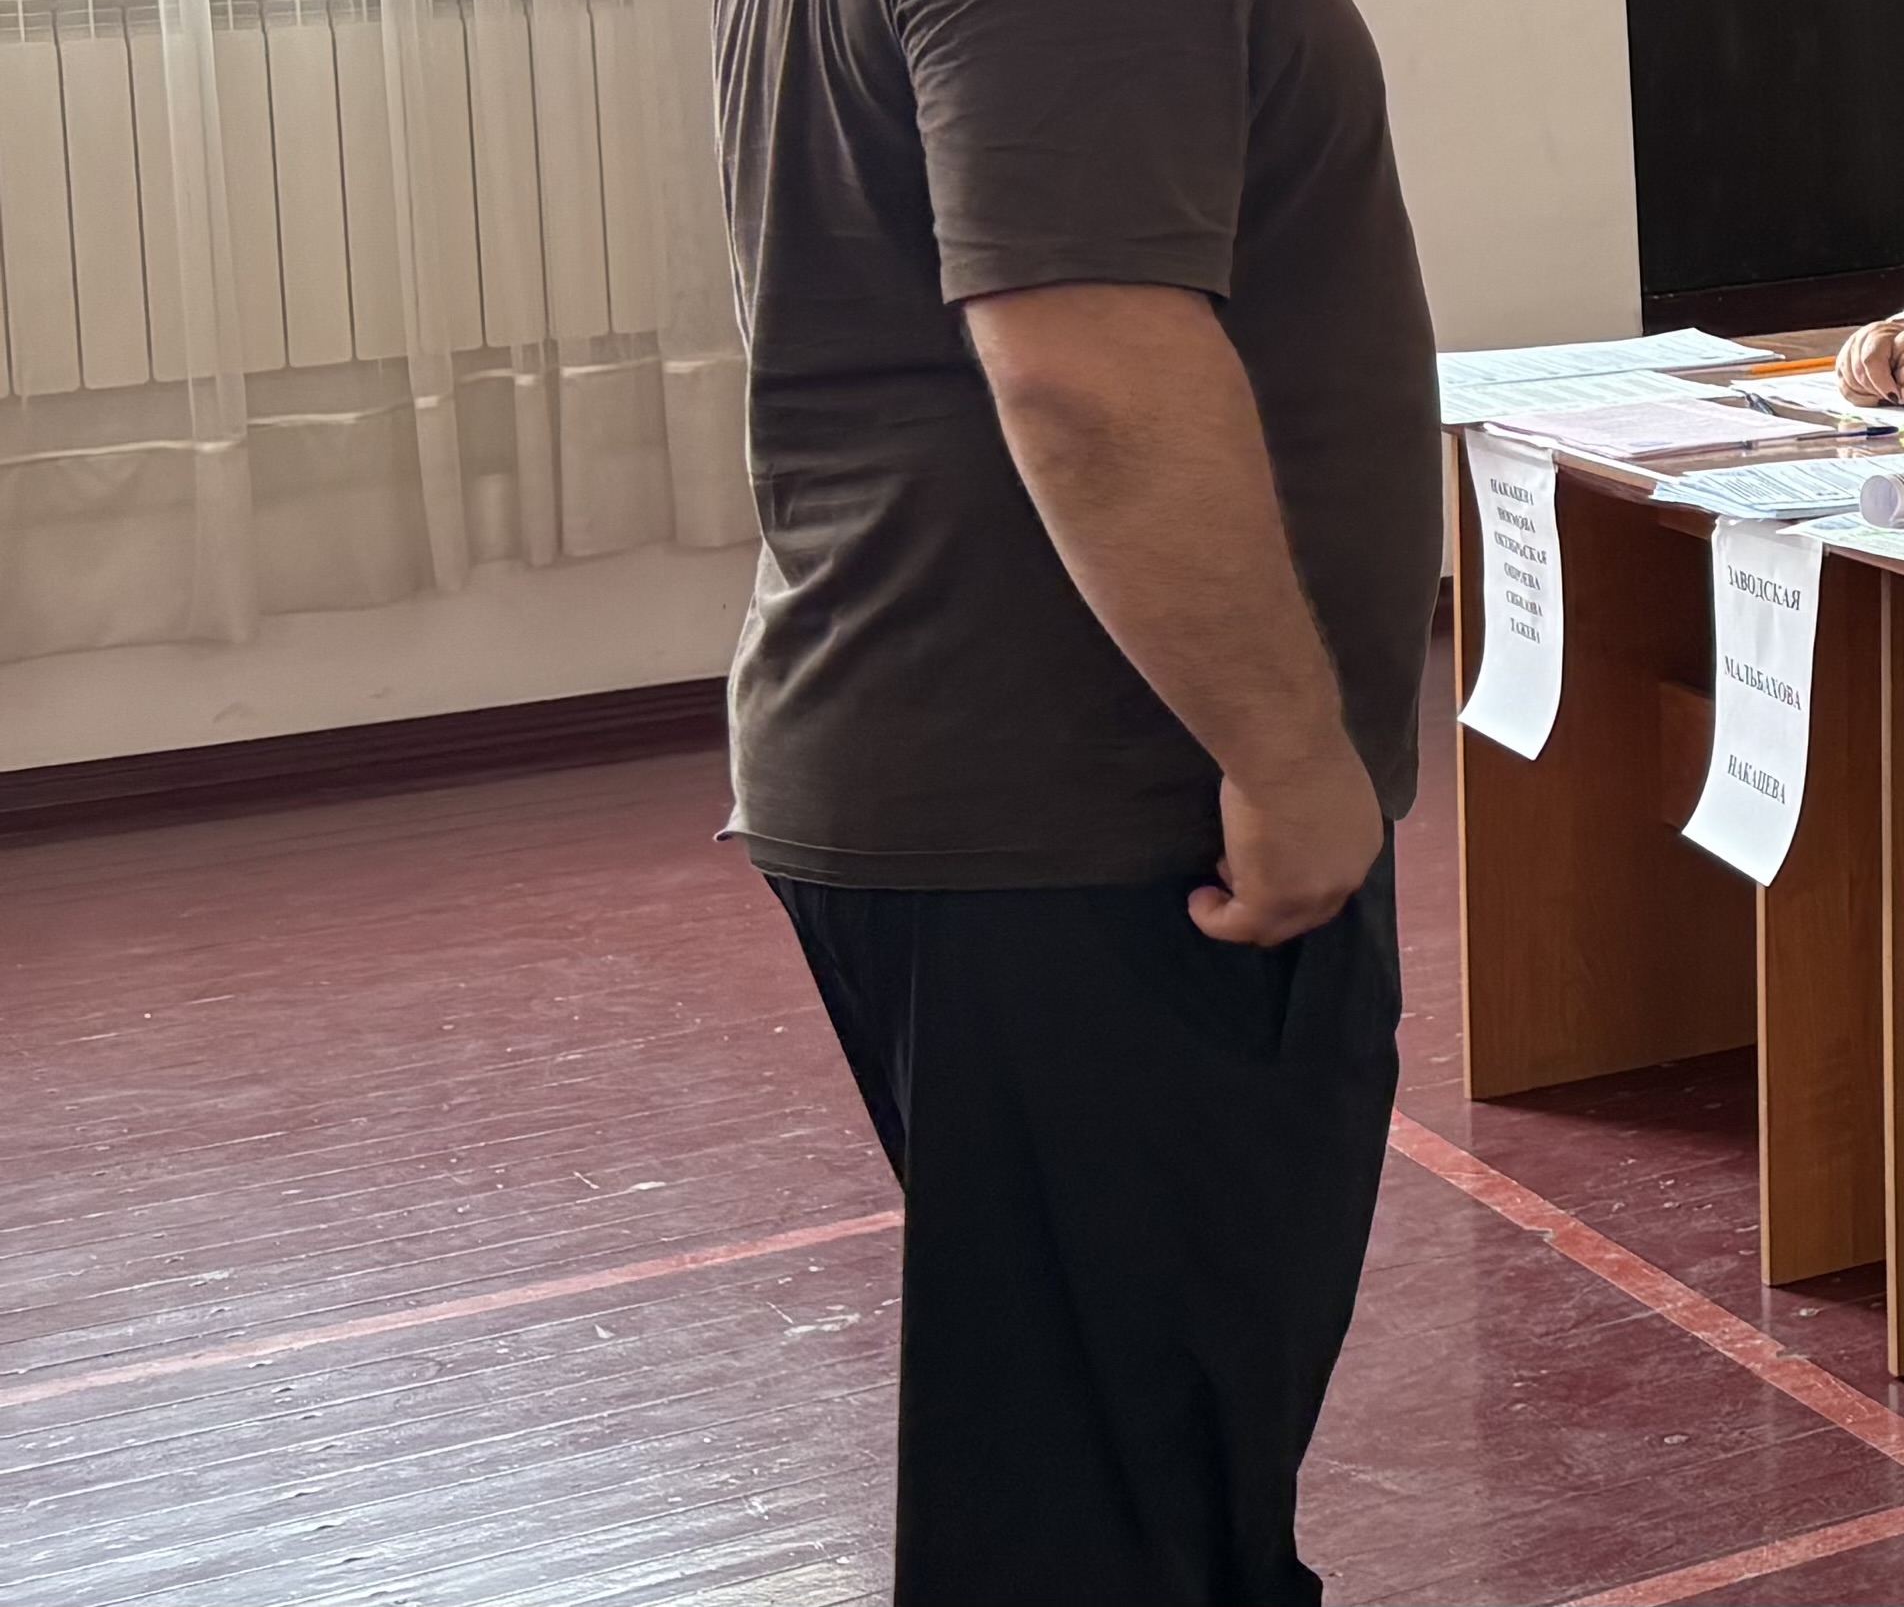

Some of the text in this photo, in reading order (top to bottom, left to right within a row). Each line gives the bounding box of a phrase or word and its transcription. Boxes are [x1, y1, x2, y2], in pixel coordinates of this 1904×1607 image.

[1726, 564, 1802, 612] ЗАВОДСКАЯ
[1724, 655, 1802, 711] МАЛЬБАХОВА
[1727, 754, 1786, 805] НАКАЦЕВА
